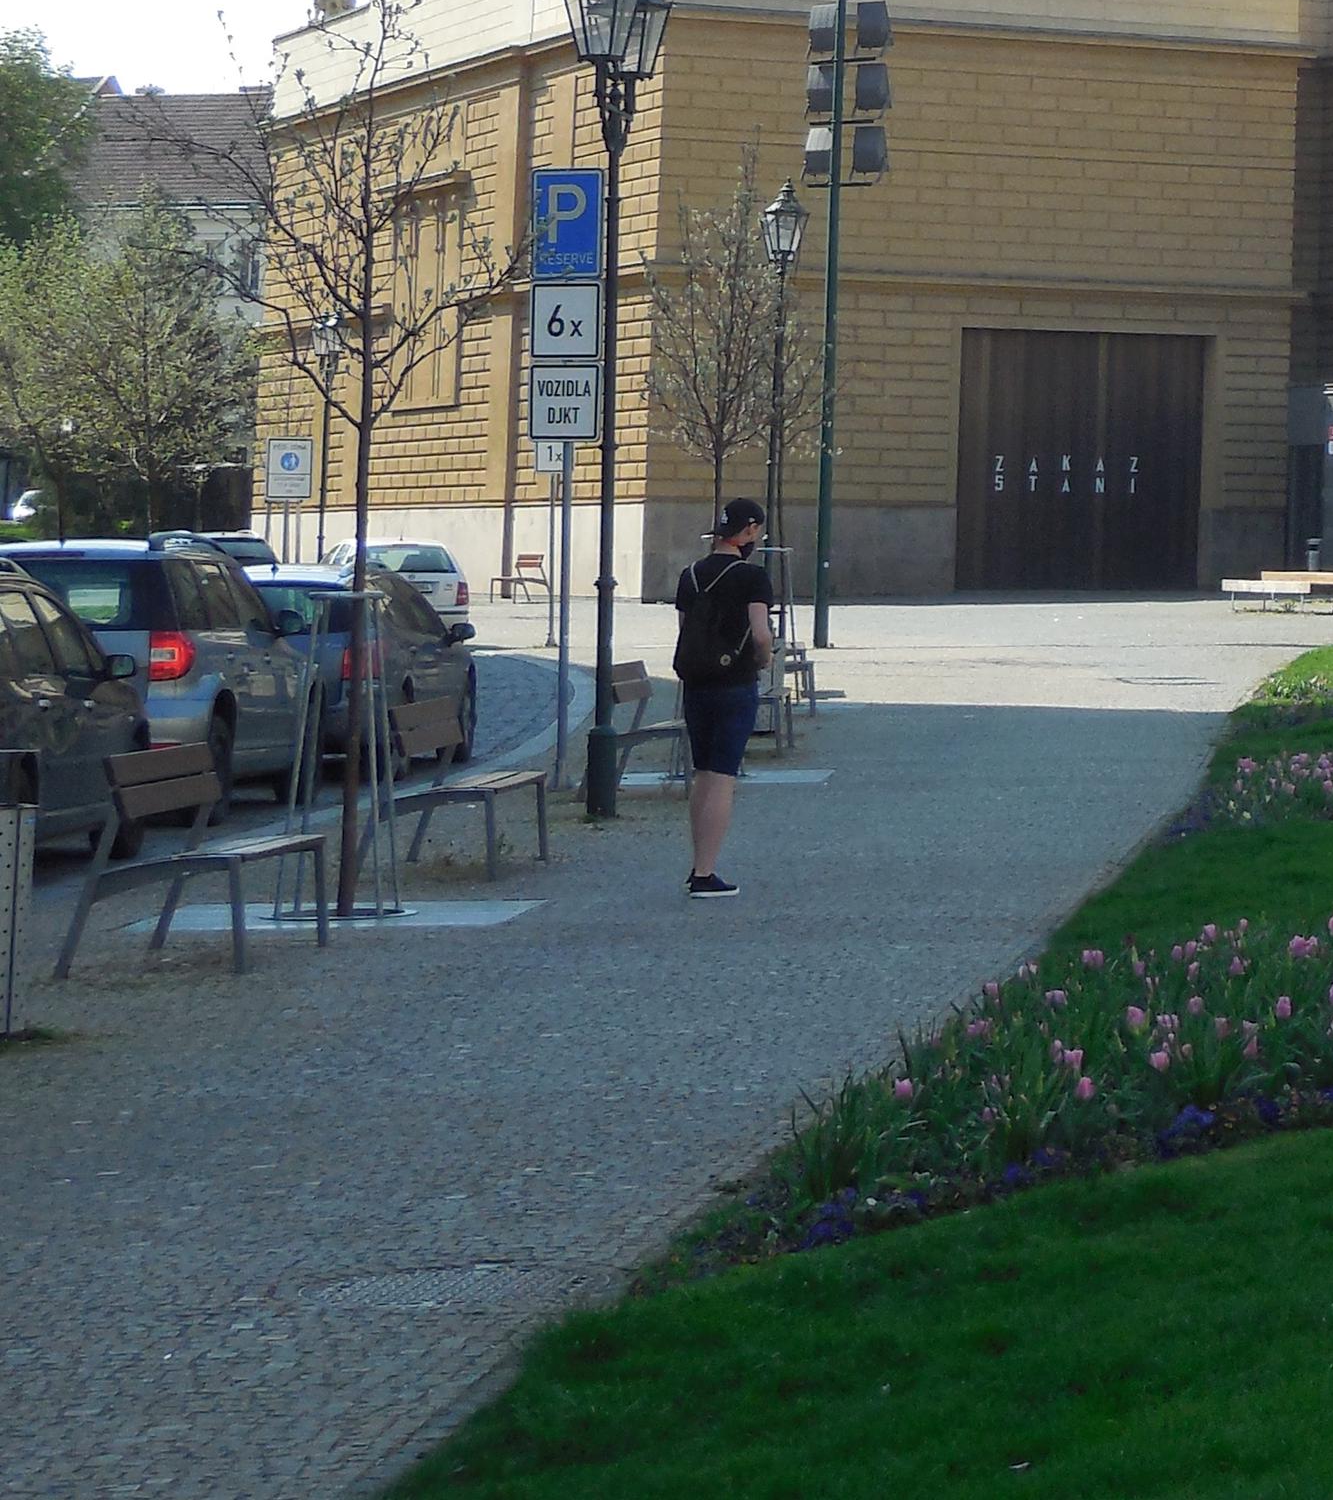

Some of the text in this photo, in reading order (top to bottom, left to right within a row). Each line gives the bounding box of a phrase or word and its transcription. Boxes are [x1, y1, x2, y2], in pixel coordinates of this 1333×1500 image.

[548, 184, 587, 243] P
[547, 304, 583, 337] 6x
[537, 380, 591, 397] VOZIDLA
[547, 407, 580, 424] DJKT
[547, 445, 563, 462] 1x
